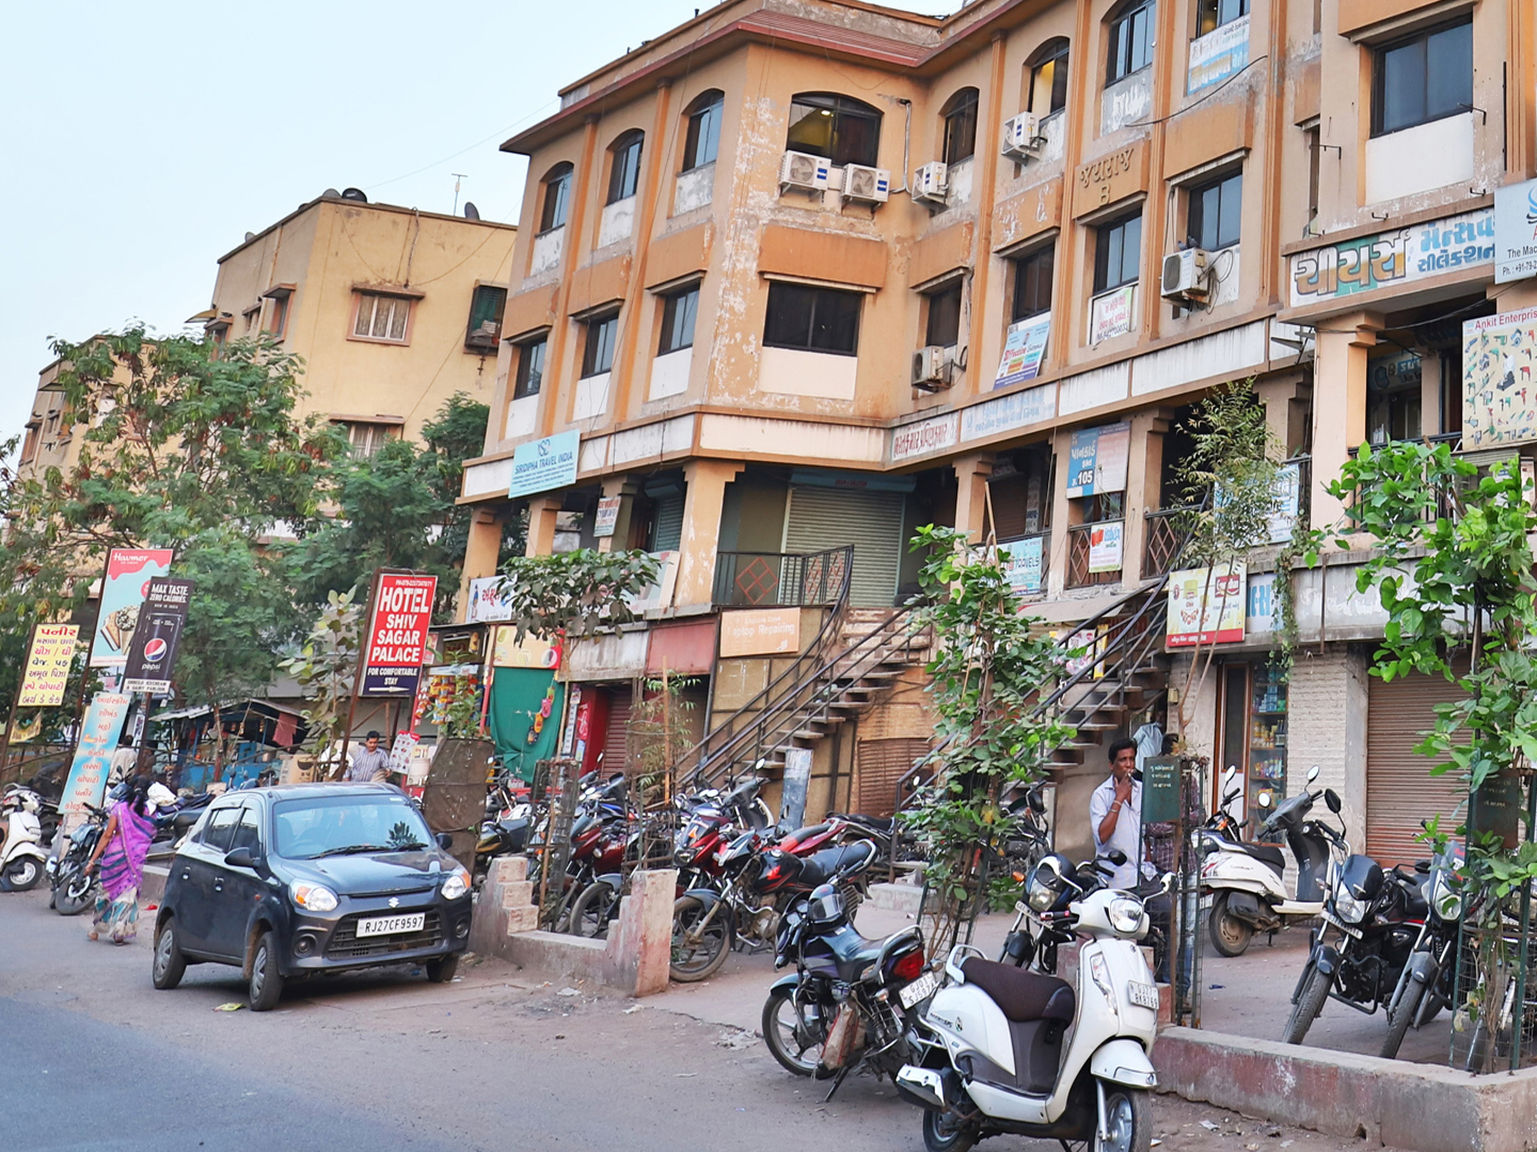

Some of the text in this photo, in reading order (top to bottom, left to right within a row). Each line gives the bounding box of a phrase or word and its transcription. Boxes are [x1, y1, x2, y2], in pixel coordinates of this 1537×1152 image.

[1098, 183, 1111, 205] B
[1506, 248, 1522, 260] The
[1474, 316, 1498, 331] Ankit
[1077, 470, 1093, 485] 105
[113, 552, 149, 562] Havmor
[151, 583, 168, 594] MAX
[379, 587, 429, 613] HOTEL
[386, 614, 418, 630] SHIV
[377, 630, 420, 645] SAGAR
[371, 646, 420, 662] PALACE
[367, 667, 418, 677] FOR COMFORTABLE
[384, 677, 399, 686] STAY
[363, 915, 424, 934] RJ27CF9597
